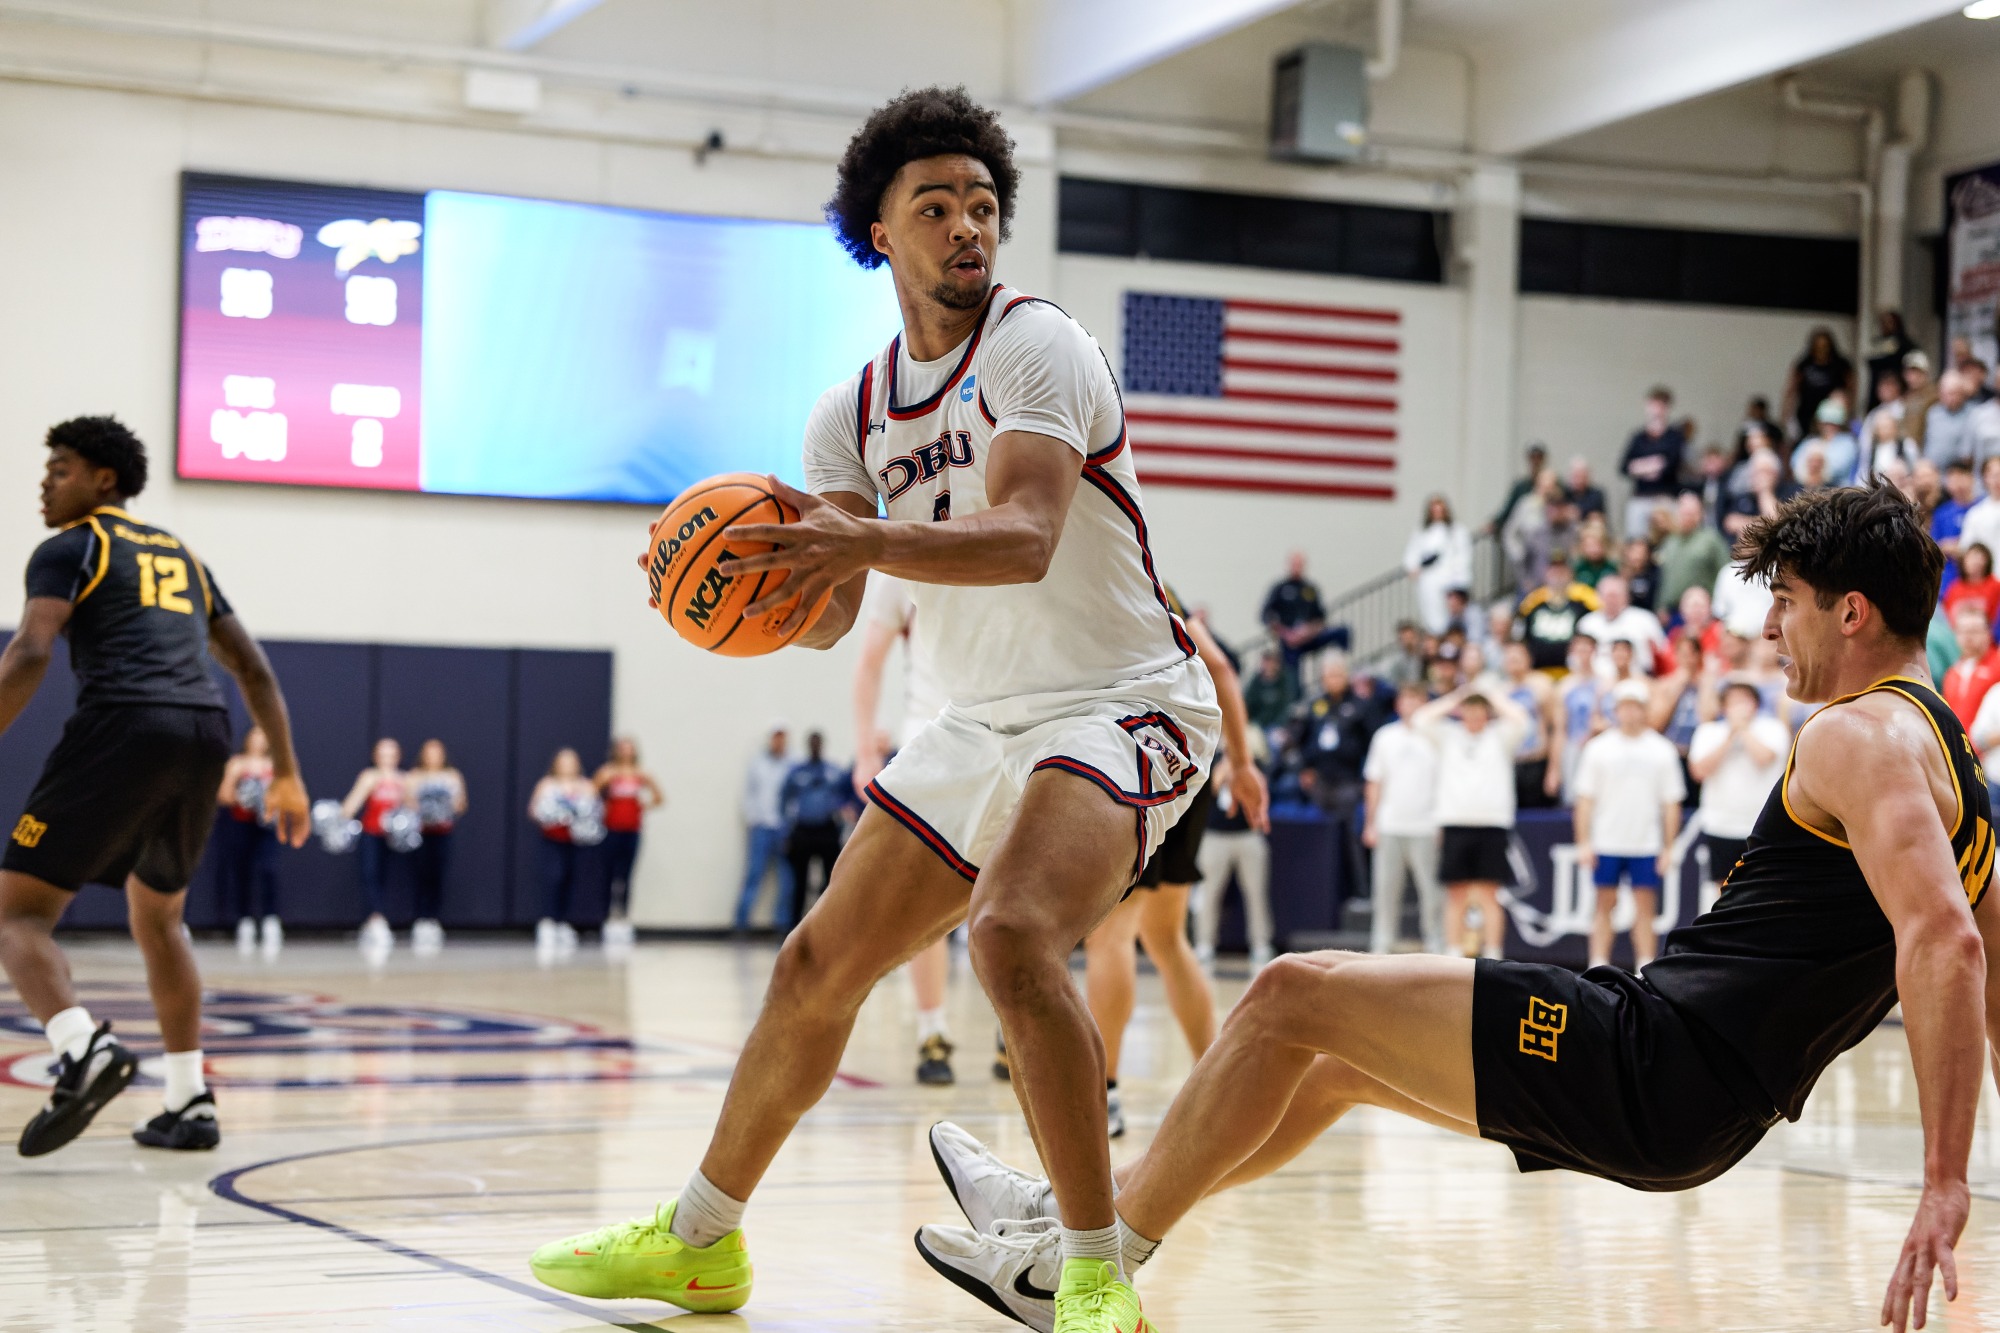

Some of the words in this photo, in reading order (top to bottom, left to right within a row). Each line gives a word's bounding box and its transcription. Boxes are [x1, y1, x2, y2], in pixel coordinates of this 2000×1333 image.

[878, 430, 975, 504] DBU
[136, 552, 193, 615] 12
[650, 506, 719, 605] Wilson
[1141, 733, 1181, 777] DBU
[1519, 995, 1568, 1062] BH
